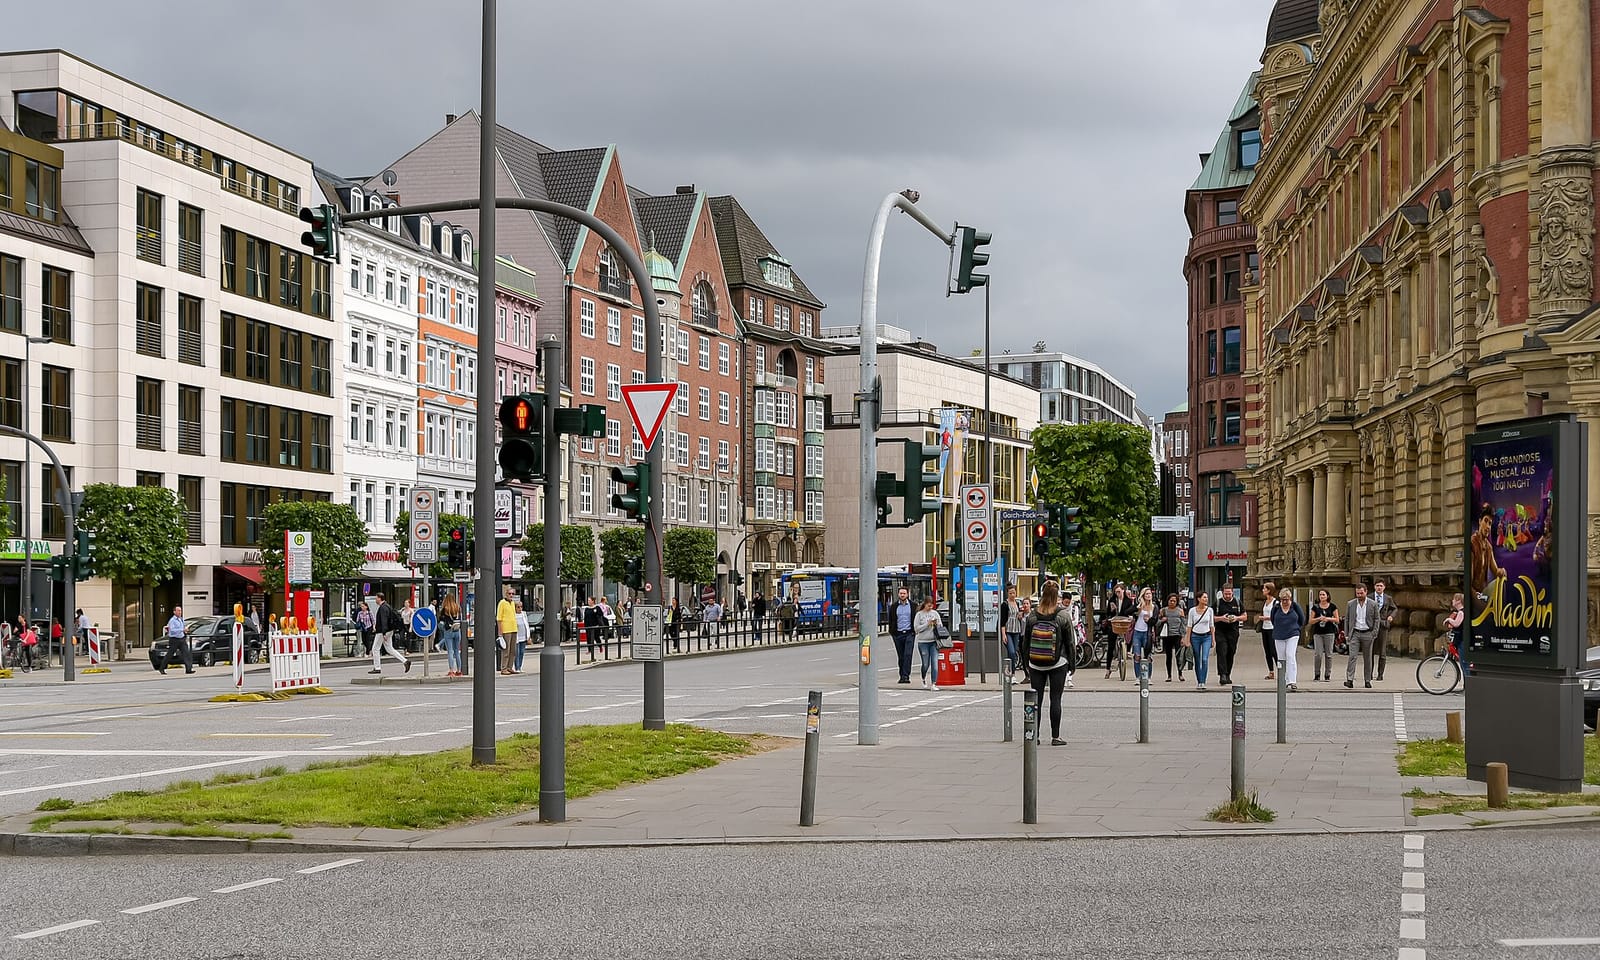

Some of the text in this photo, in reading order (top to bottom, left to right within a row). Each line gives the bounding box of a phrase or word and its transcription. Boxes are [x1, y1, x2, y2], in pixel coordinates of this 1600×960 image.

[1484, 452, 1541, 468] DAS GRANDIOSE
[1490, 465, 1536, 479] MUSICAL AUS
[1492, 478, 1530, 491] 1001 NACHT
[15, 541, 51, 553] PAPAYA
[1215, 550, 1248, 560] Santande
[1471, 575, 1553, 629] Aladdin
